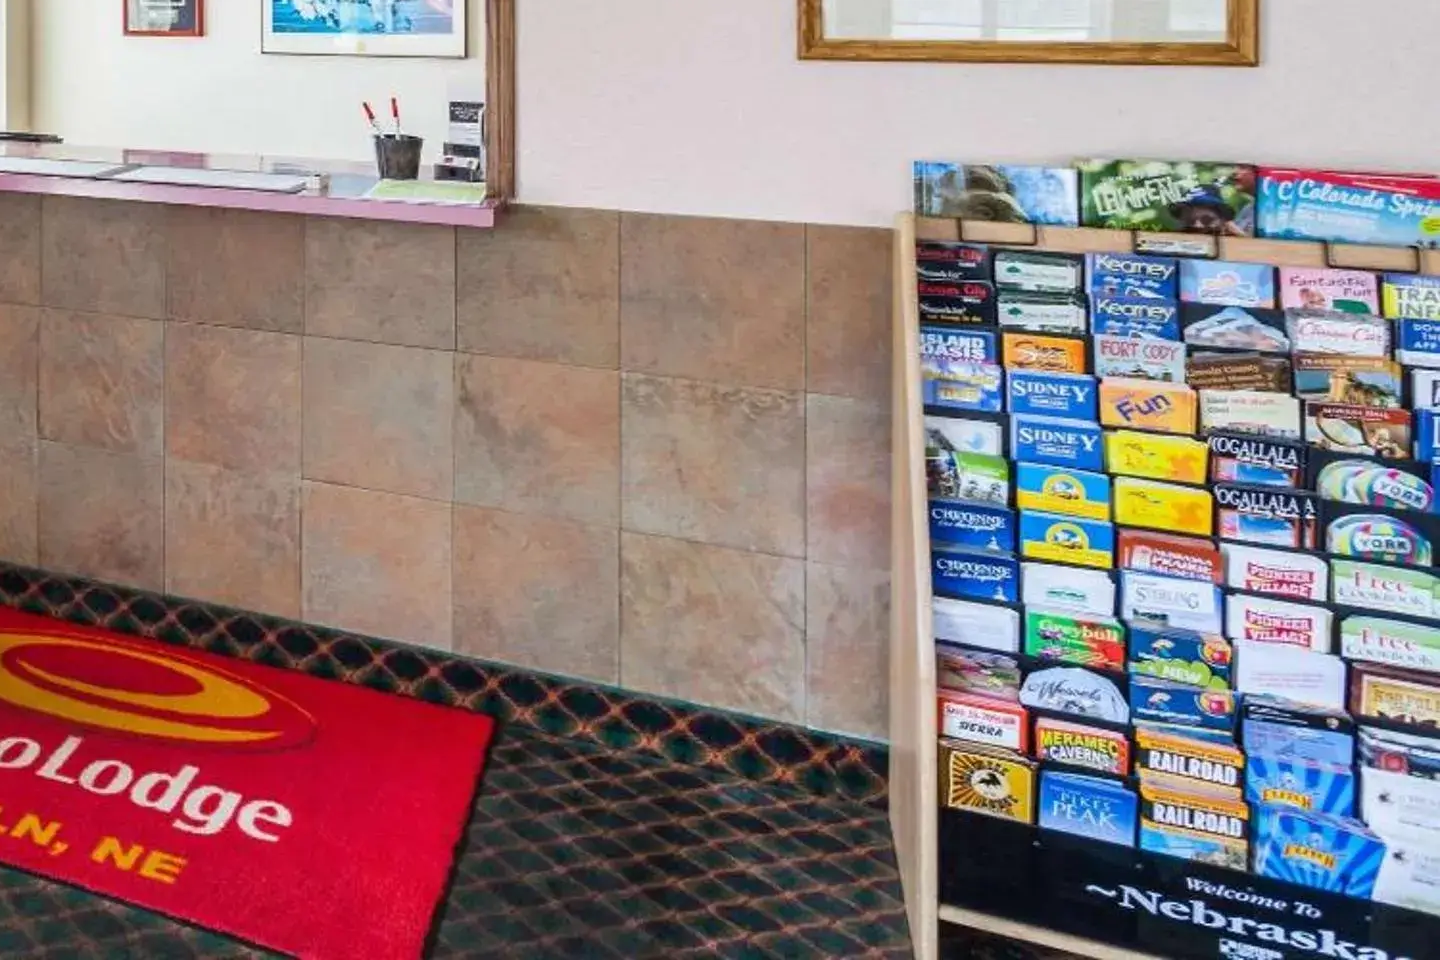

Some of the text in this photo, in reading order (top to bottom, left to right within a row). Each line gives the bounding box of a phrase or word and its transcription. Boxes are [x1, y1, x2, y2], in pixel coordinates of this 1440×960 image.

[1298, 178, 1386, 210] Colorado
[1095, 253, 1175, 280] Kearney
[1289, 275, 1369, 288] Fantastic
[1343, 286, 1372, 298] Fun
[1097, 299, 1175, 323] Kearney
[920, 333, 985, 349] ISLAND
[920, 343, 987, 360] OASIS
[1100, 339, 1180, 361] FORT CODY
[1012, 379, 1090, 403] SIDNEY
[1116, 393, 1172, 422] Fun
[1019, 427, 1098, 452] SIDNEY
[1380, 483, 1423, 503] YORK
[931, 507, 1006, 529] CHEYENNE
[1360, 538, 1407, 551] YORK
[936, 558, 1013, 579] CHEYENNE
[1249, 579, 1311, 598] VILLAGE
[1249, 627, 1310, 646] VILLAGE
[1361, 626, 1416, 652] Free
[1041, 730, 1120, 755] MERAMEC
[1049, 745, 1119, 771] CAVERNS
[1149, 750, 1238, 786] RAILROAD
[1060, 792, 1110, 811] PIKES
[1053, 799, 1120, 831] PEAK
[1153, 804, 1243, 838] RAILROAD
[90, 836, 189, 885] NE
[1185, 877, 1323, 919] Welcome To
